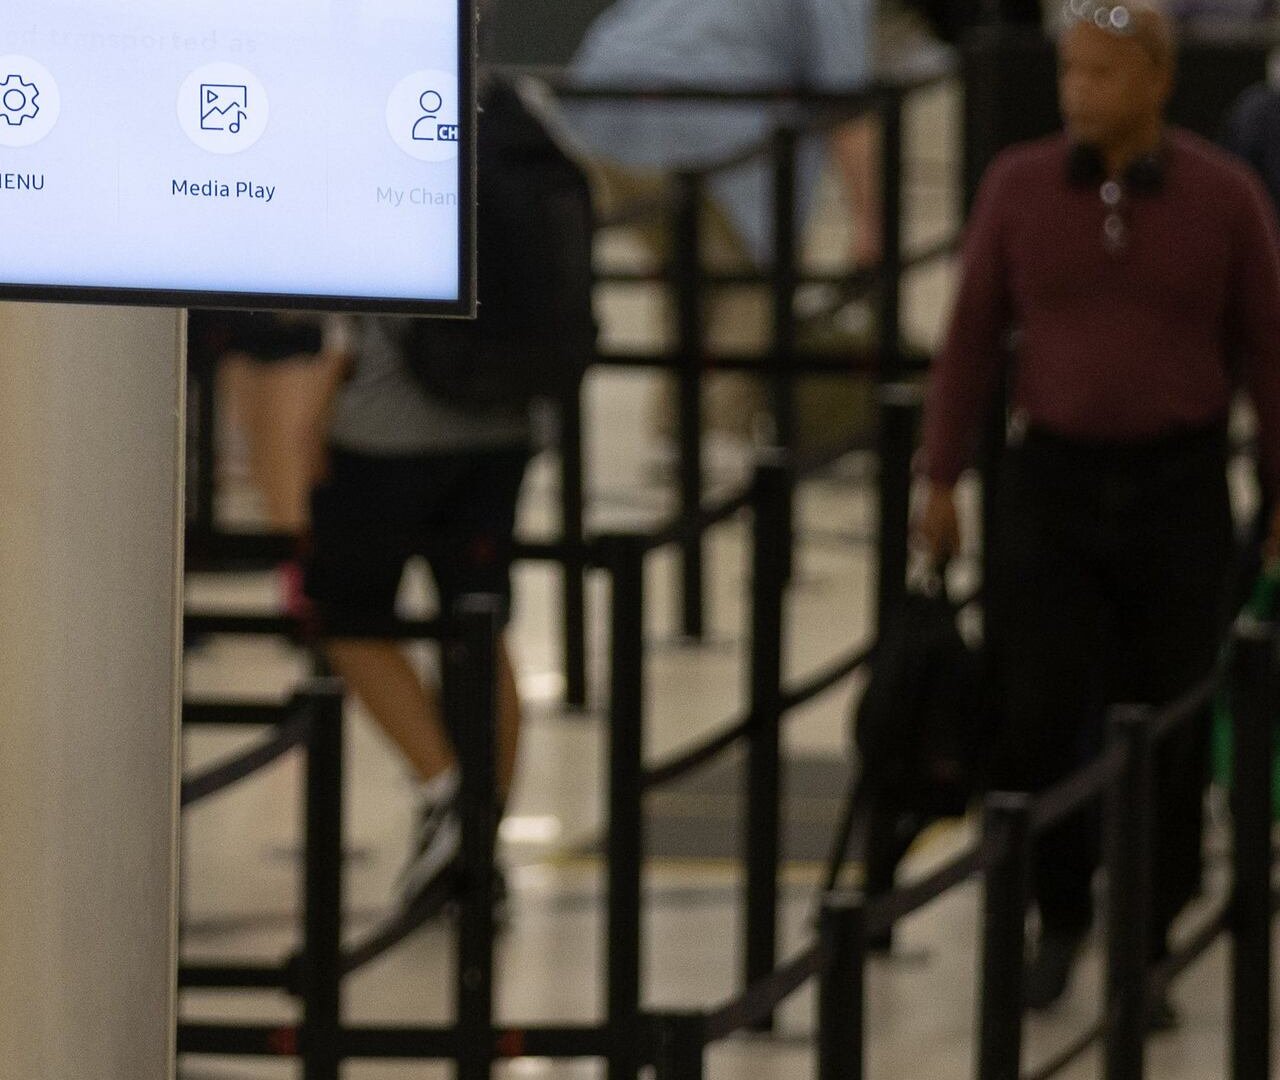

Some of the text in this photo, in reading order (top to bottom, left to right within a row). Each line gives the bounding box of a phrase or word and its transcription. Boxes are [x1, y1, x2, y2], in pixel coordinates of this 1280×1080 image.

[172, 179, 276, 203] Media Play
[376, 187, 404, 206] My
